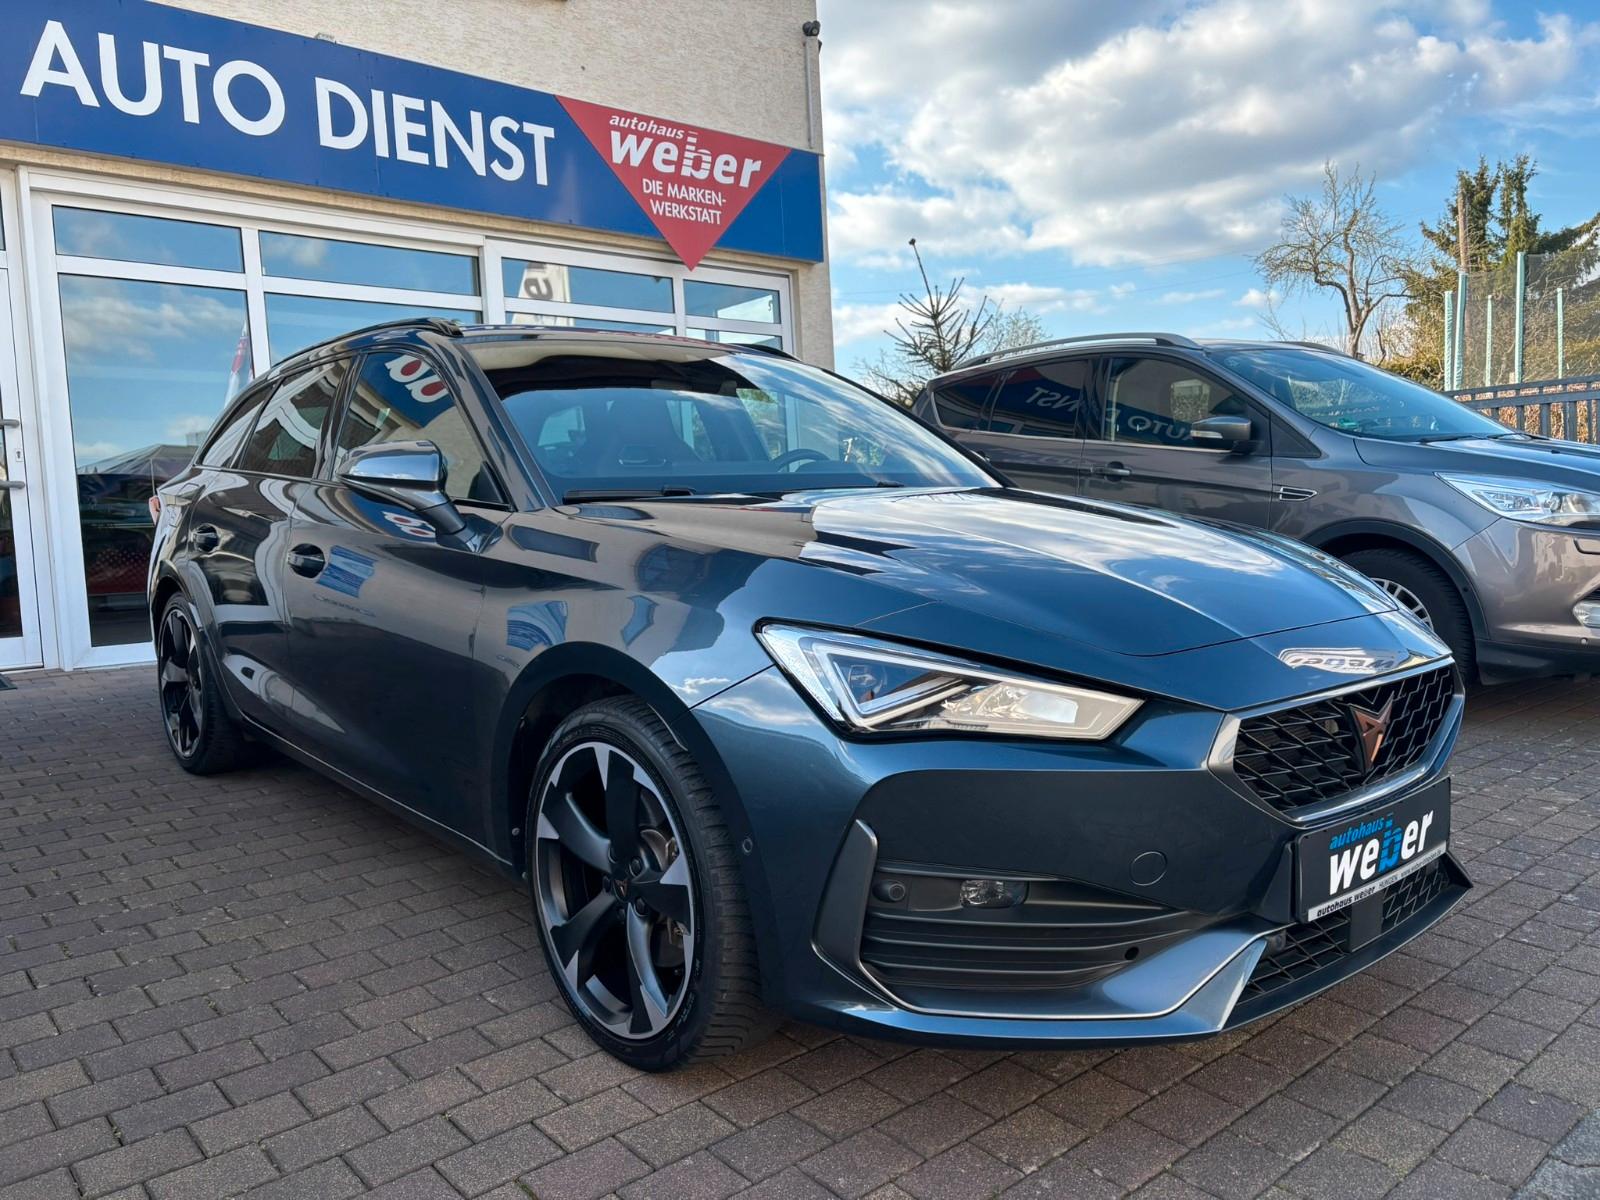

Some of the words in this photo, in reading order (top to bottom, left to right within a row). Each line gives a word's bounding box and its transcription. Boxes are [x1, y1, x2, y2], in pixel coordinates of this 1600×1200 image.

[20, 20, 286, 136] AUTO
[314, 77, 555, 186] DIENST
[609, 115, 685, 140] autohaus
[610, 130, 762, 188] weber
[642, 178, 663, 196] DIE
[667, 182, 726, 206] MARKEN-
[650, 199, 721, 225] WERKSTATT
[1329, 817, 1384, 850] autohaus
[1329, 810, 1434, 896] weber
[1316, 896, 1353, 917] autohaus
